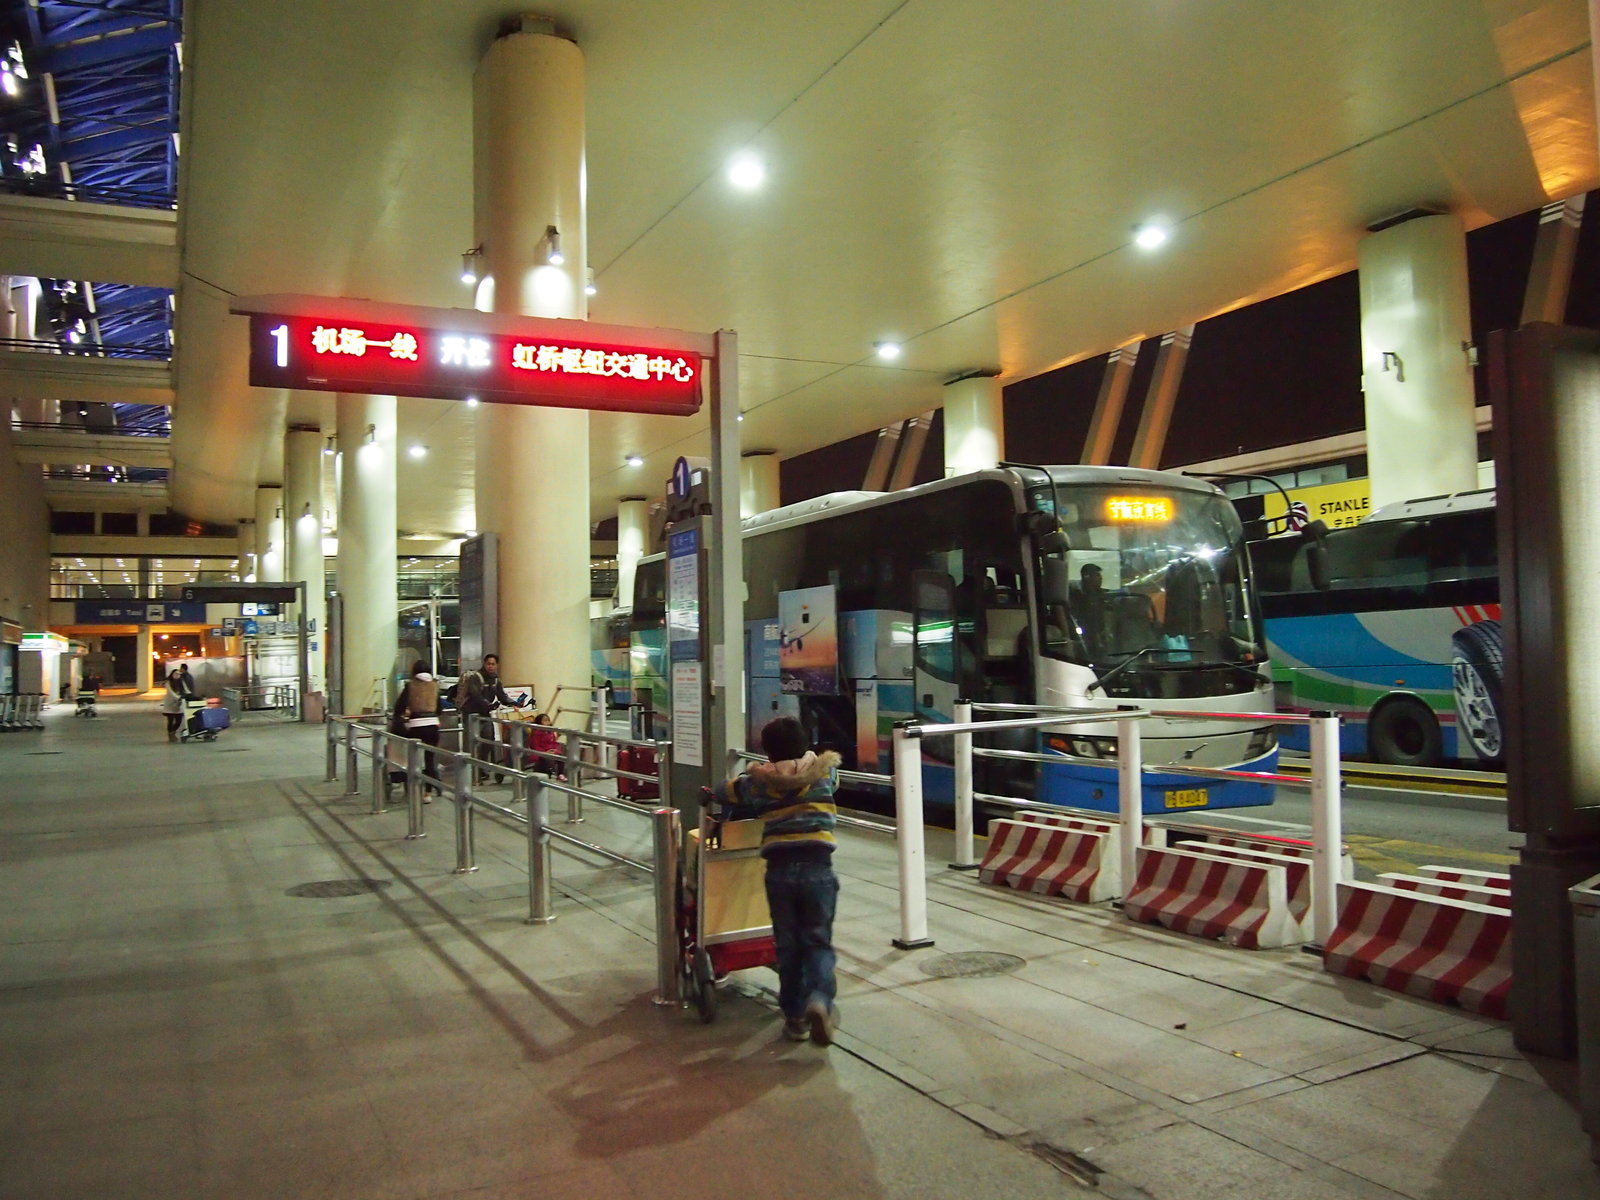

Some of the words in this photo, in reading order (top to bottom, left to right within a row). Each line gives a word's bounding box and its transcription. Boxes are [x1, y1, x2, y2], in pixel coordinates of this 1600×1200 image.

[270, 324, 289, 368] 1
[312, 326, 418, 361] 机场一线
[512, 343, 694, 382] 虹桥枢纽交通中心
[677, 470, 686, 495] 1
